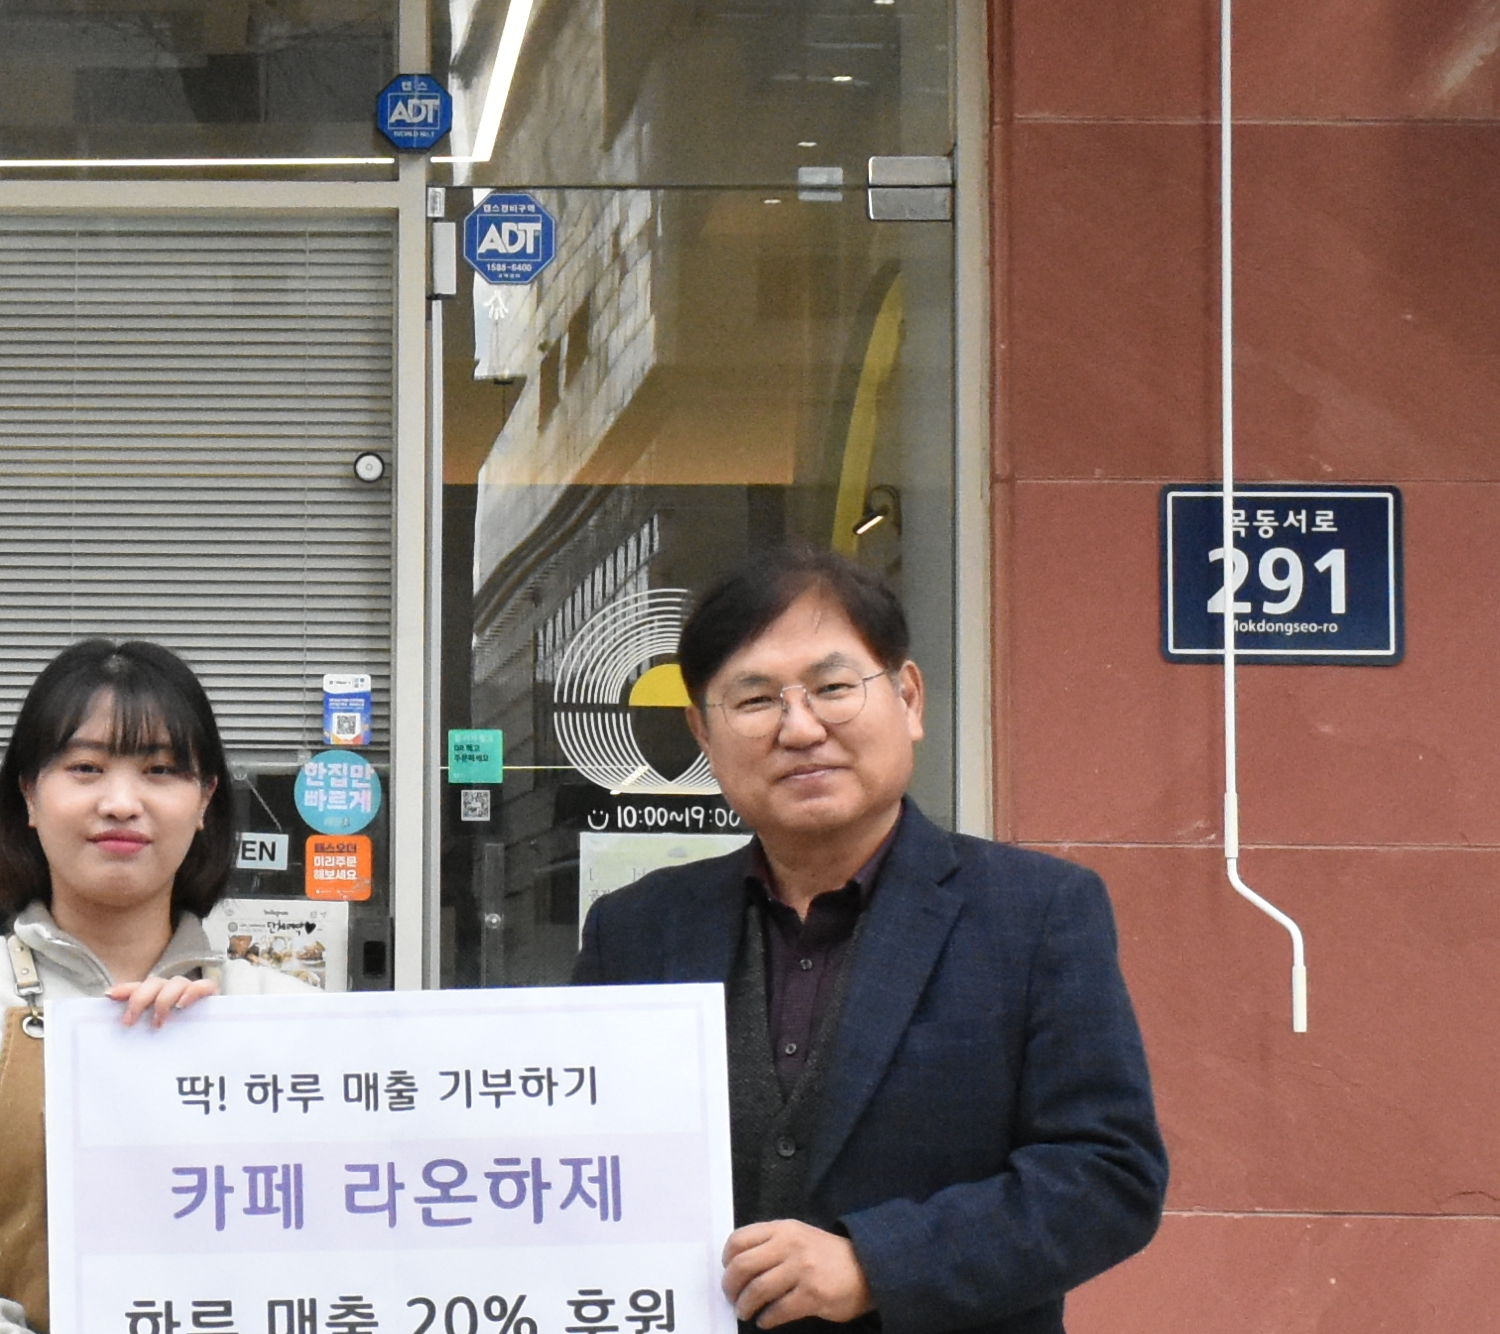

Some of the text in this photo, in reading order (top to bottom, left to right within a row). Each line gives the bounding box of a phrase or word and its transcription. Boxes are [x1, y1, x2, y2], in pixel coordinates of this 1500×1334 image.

[389, 99, 440, 123] ADT
[478, 222, 542, 255] ADT
[1207, 547, 1346, 615] 291
[304, 762, 374, 788] 한집만
[304, 790, 372, 813] 빠르게
[241, 839, 276, 862] EN
[313, 855, 357, 868] 미리주문
[313, 869, 357, 880] 해보세요
[176, 1065, 599, 1114] 딱! 하루 매출 기부하기
[171, 1154, 624, 1231] 카페 라온하제
